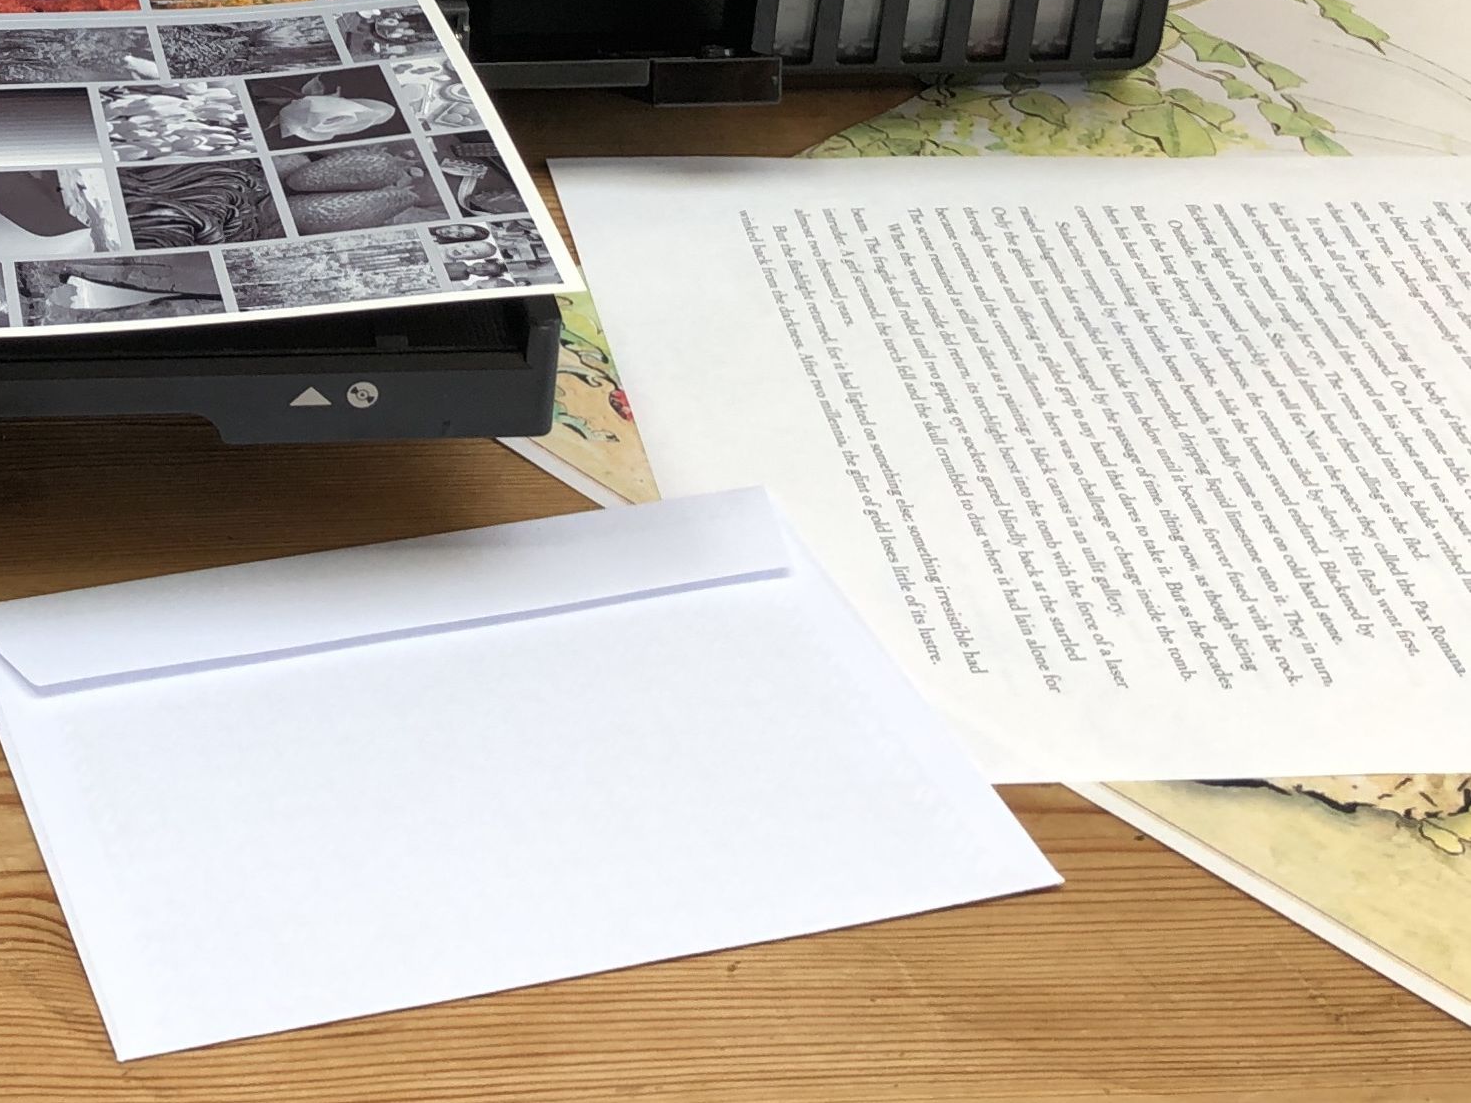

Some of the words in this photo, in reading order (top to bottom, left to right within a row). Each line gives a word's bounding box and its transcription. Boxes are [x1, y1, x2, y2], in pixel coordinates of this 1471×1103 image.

[738, 209, 764, 242] winked
[772, 225, 787, 242] But
[751, 244, 772, 265] back
[779, 243, 796, 258] the
[793, 208, 814, 238] almost
[807, 239, 821, 257] two
[815, 258, 848, 298] thousand
[863, 236, 881, 254] The
[839, 258, 864, 273] girl
[871, 256, 897, 284] fragile
[761, 267, 777, 288] from
[786, 259, 816, 300] flashlight
[771, 289, 788, 304] the
[886, 285, 911, 307] skull
[874, 321, 892, 336] the
[897, 309, 925, 335] rolled
[825, 346, 842, 361] for
[882, 338, 907, 363] torch
[912, 337, 937, 358] until
[798, 352, 818, 378] After
[895, 365, 917, 380] fell
[923, 361, 940, 379] two
[809, 379, 826, 398] two
[837, 371, 860, 390] had
[903, 381, 927, 400] and
[844, 391, 876, 426] lighted
[929, 381, 959, 414] gaping
[913, 402, 932, 418] the
[863, 427, 876, 440] on
[921, 420, 949, 445] skull
[948, 416, 967, 433] eye
[841, 449, 859, 466] the
[961, 435, 987, 473] sockets
[845, 468, 870, 493] glint
[869, 443, 902, 496] something
[935, 446, 974, 496] crumbled
[861, 494, 882, 508] of
[975, 475, 1010, 506] gazed
[959, 498, 973, 511] to
[862, 508, 893, 533] gold
[966, 512, 987, 536] dust
[997, 508, 1027, 548] blindly
[878, 535, 899, 563] loses
[906, 524, 941, 583] something
[980, 539, 1003, 574] where
[1017, 550, 1044, 577] back
[891, 565, 916, 592] little
[996, 577, 1013, 585] it
[1031, 580, 1046, 592] at
[904, 594, 926, 608] of
[1002, 588, 1028, 611] had
[1038, 594, 1058, 613] the
[910, 609, 927, 625] its
[933, 585, 974, 648] irresistible
[1013, 613, 1035, 635] lain
[1049, 616, 1087, 661] startled
[962, 650, 989, 673] had
[1025, 638, 1049, 670] alone
[1042, 674, 1062, 693] for
